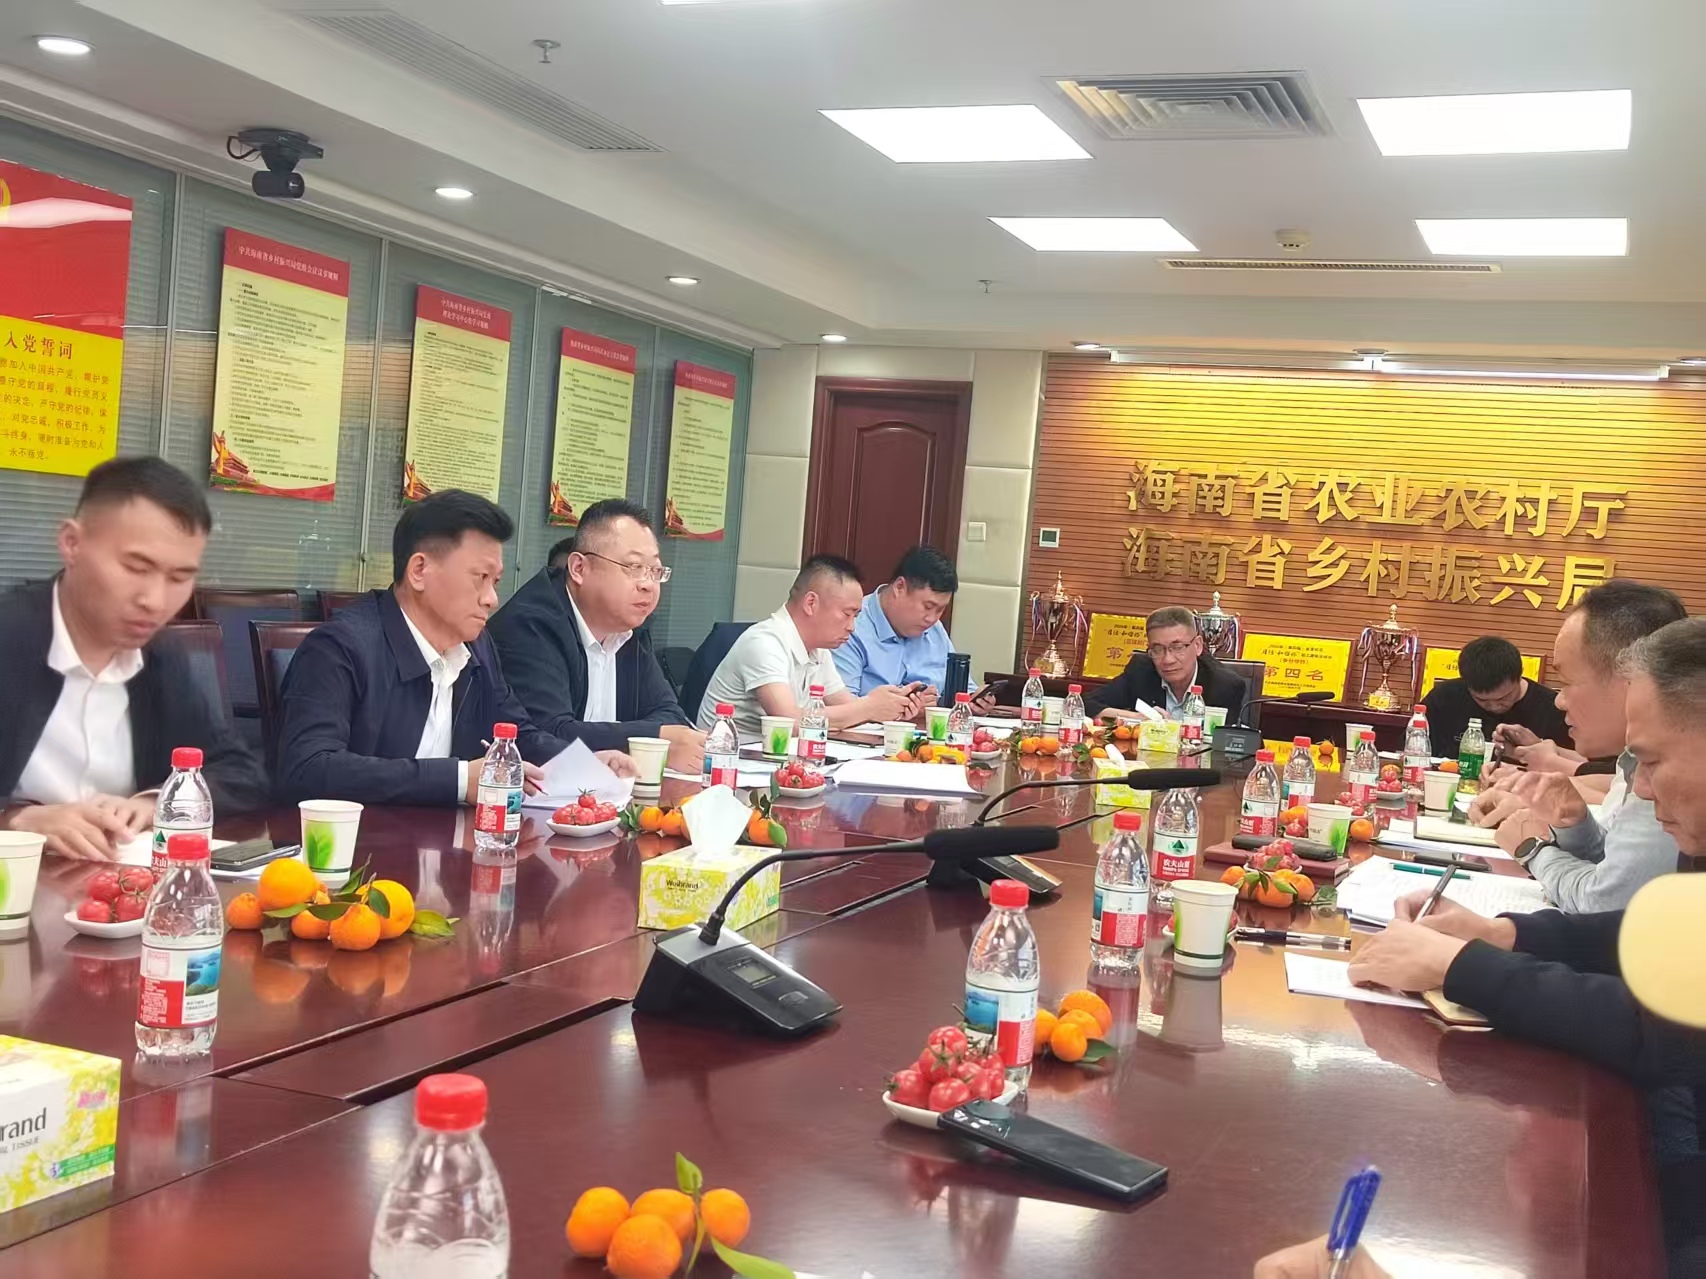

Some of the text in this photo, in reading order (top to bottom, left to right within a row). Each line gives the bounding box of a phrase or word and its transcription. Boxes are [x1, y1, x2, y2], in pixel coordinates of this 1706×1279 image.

[4, 330, 73, 360] 入党誓词
[1127, 459, 1630, 541] 海南省农业农村厅
[1120, 526, 1617, 612] 海南省乡村振兴局
[1264, 665, 1324, 681] 第四名
[0, 1106, 47, 1142] rand
